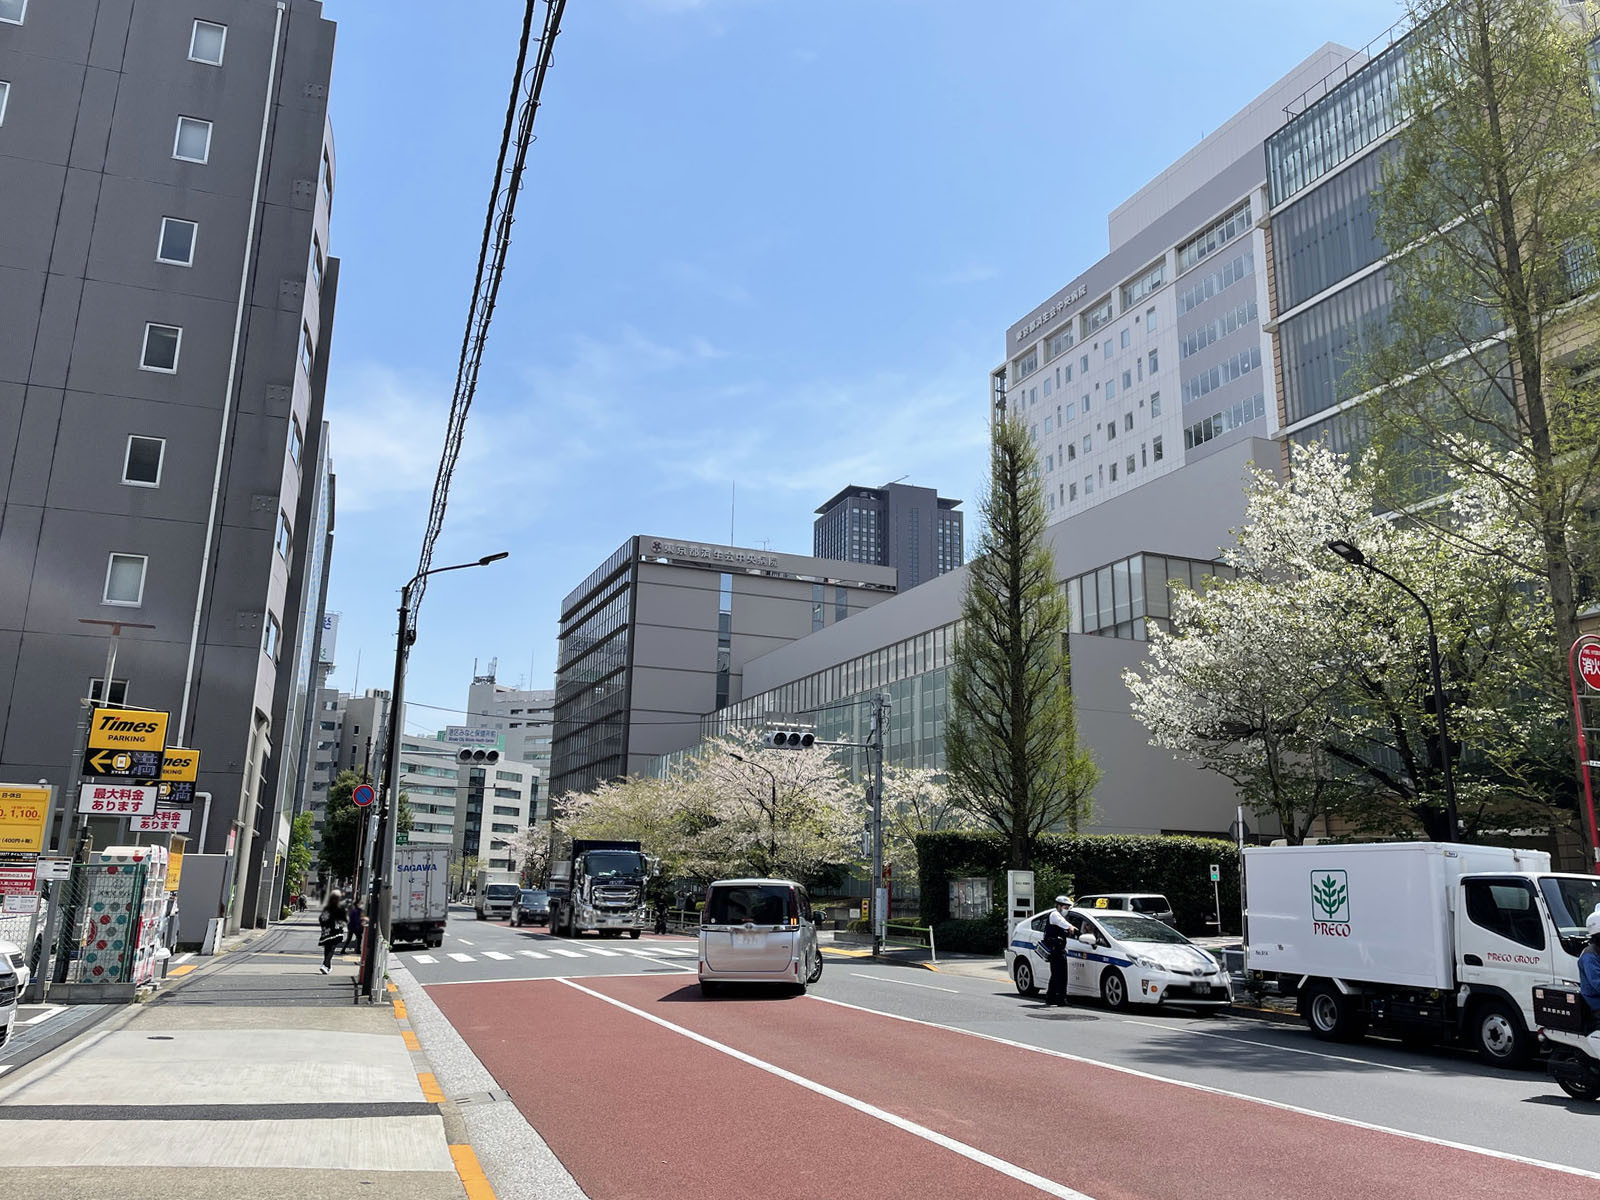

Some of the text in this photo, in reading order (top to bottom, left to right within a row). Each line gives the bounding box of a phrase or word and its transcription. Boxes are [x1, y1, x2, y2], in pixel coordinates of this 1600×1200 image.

[98, 716, 159, 733] Times
[107, 734, 146, 743] PARKING
[163, 757, 192, 768] mes
[93, 787, 145, 801] 最大料金
[91, 800, 143, 812] あります
[140, 820, 180, 830] あります
[397, 864, 437, 873] SAGAWA
[1313, 922, 1351, 937] PRECO
[1487, 952, 1541, 965] PRECO GROUP
